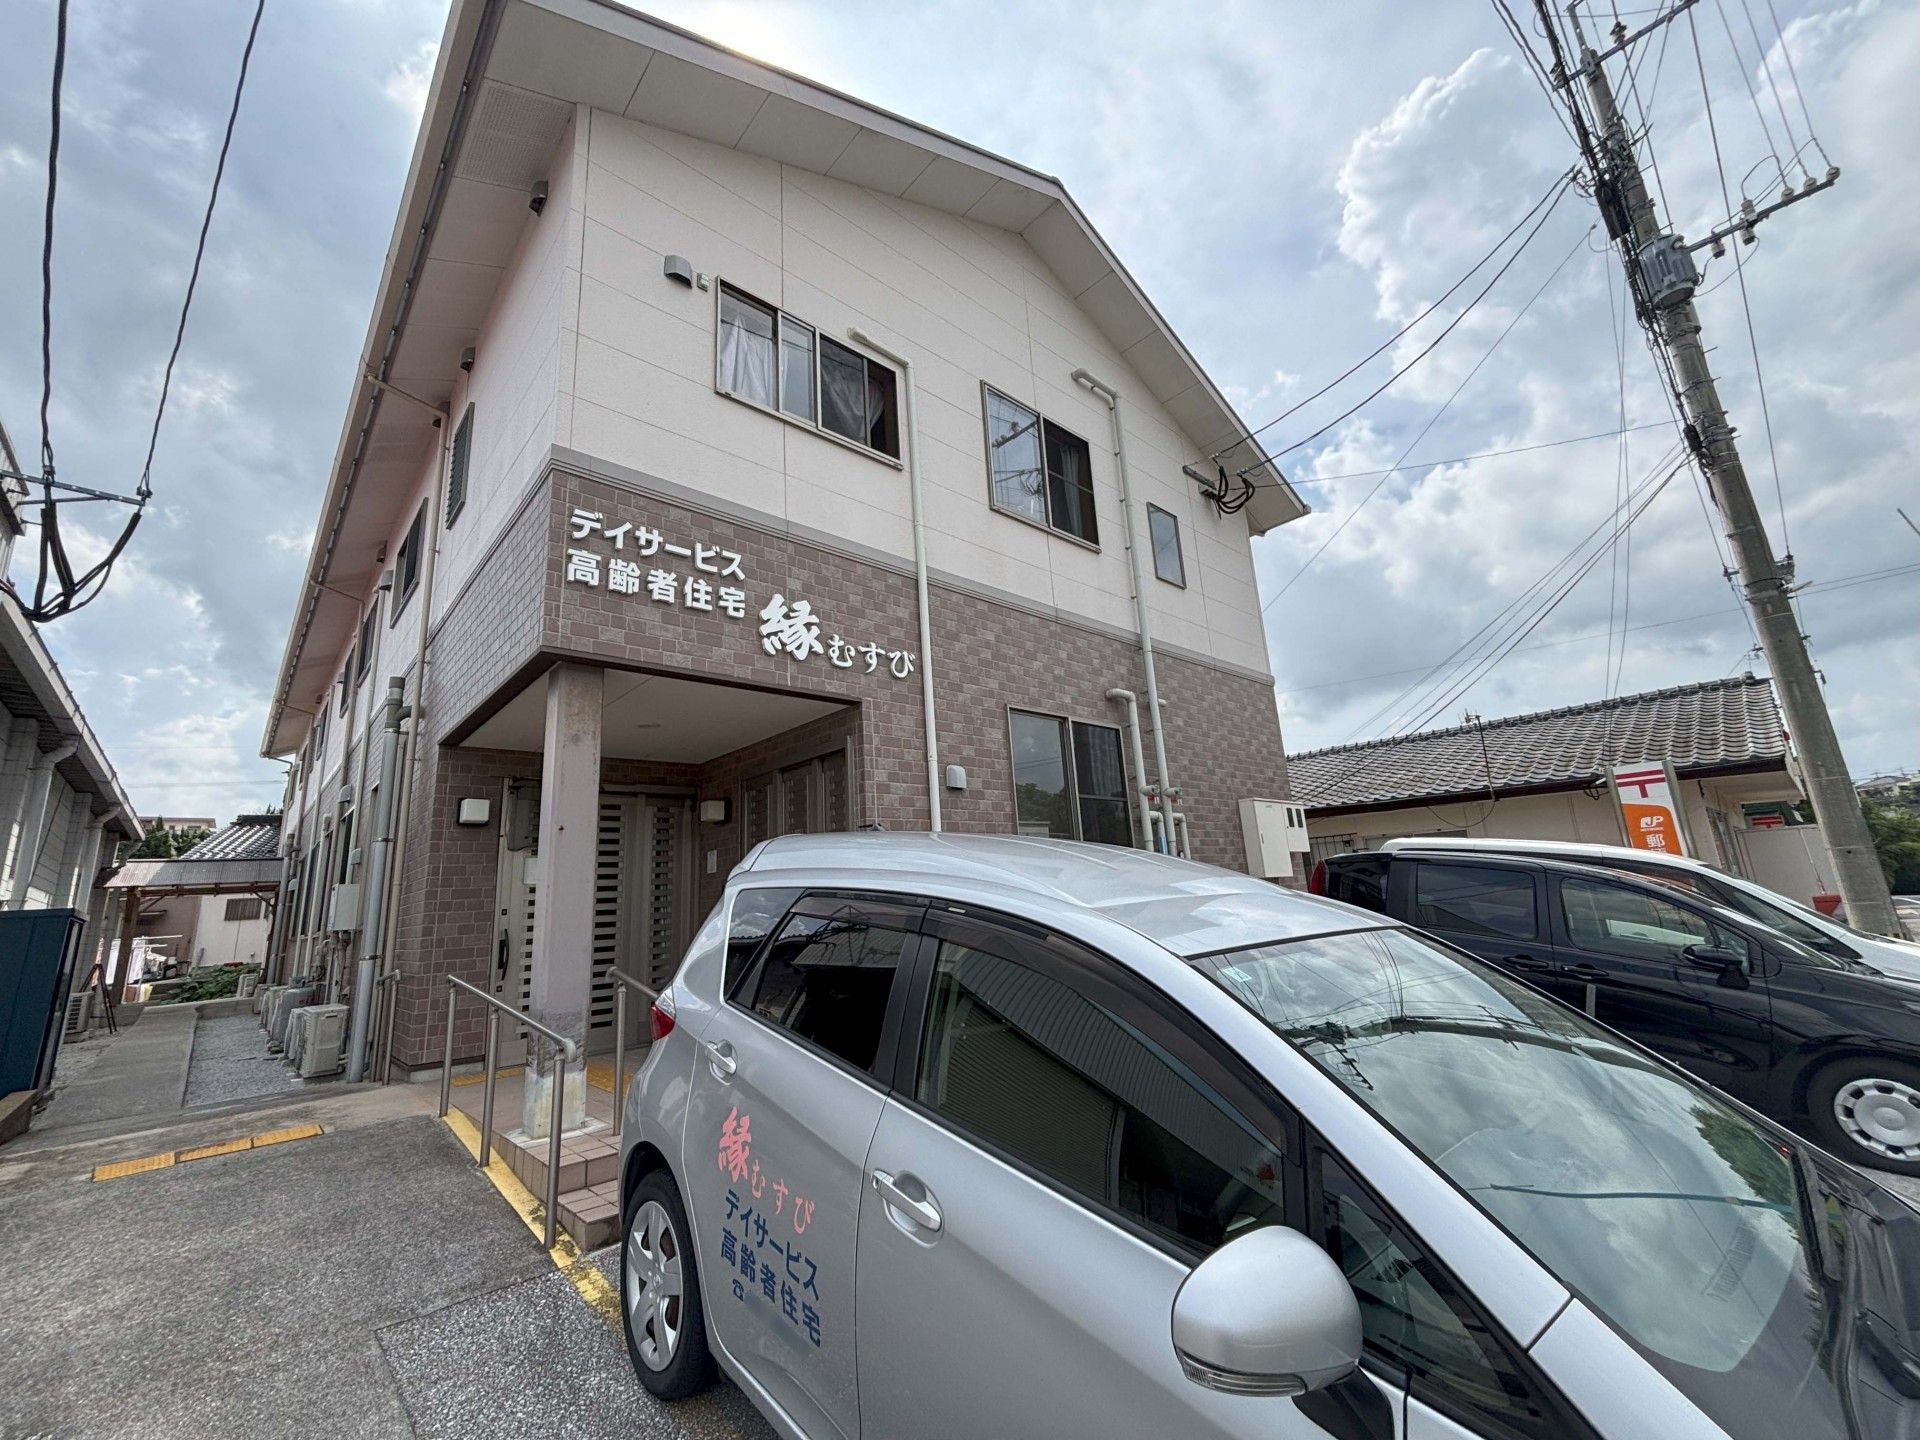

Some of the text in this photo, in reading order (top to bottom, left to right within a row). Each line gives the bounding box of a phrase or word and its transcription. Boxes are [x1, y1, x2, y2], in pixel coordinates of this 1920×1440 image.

[567, 549, 746, 618] 高齢者住宅
[570, 508, 746, 581] デイサービス
[758, 593, 915, 679] 縁むすび
[718, 1106, 815, 1234] 縁むすび
[720, 1227, 821, 1348] 高齢者住宅
